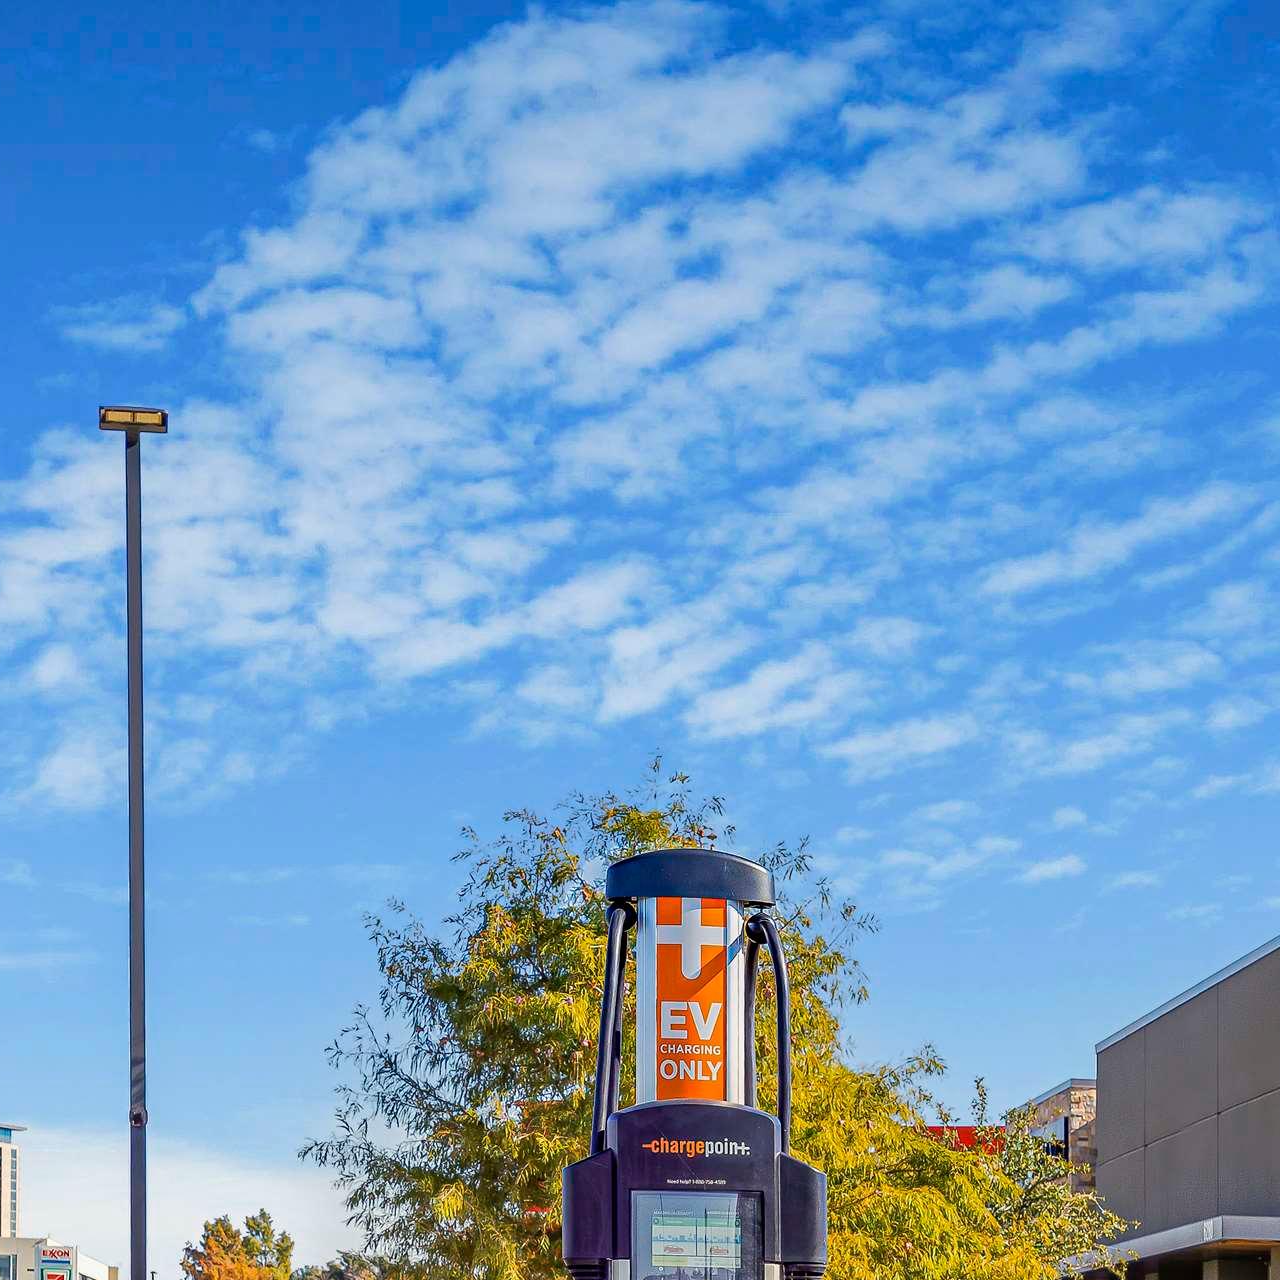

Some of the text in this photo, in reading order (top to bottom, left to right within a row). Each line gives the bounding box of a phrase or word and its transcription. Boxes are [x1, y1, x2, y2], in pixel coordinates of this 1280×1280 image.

[660, 1001, 722, 1041] EV
[660, 1044, 721, 1055] CHARGING
[660, 1059, 722, 1081] ONLY
[42, 1249, 70, 1259] EXXON
